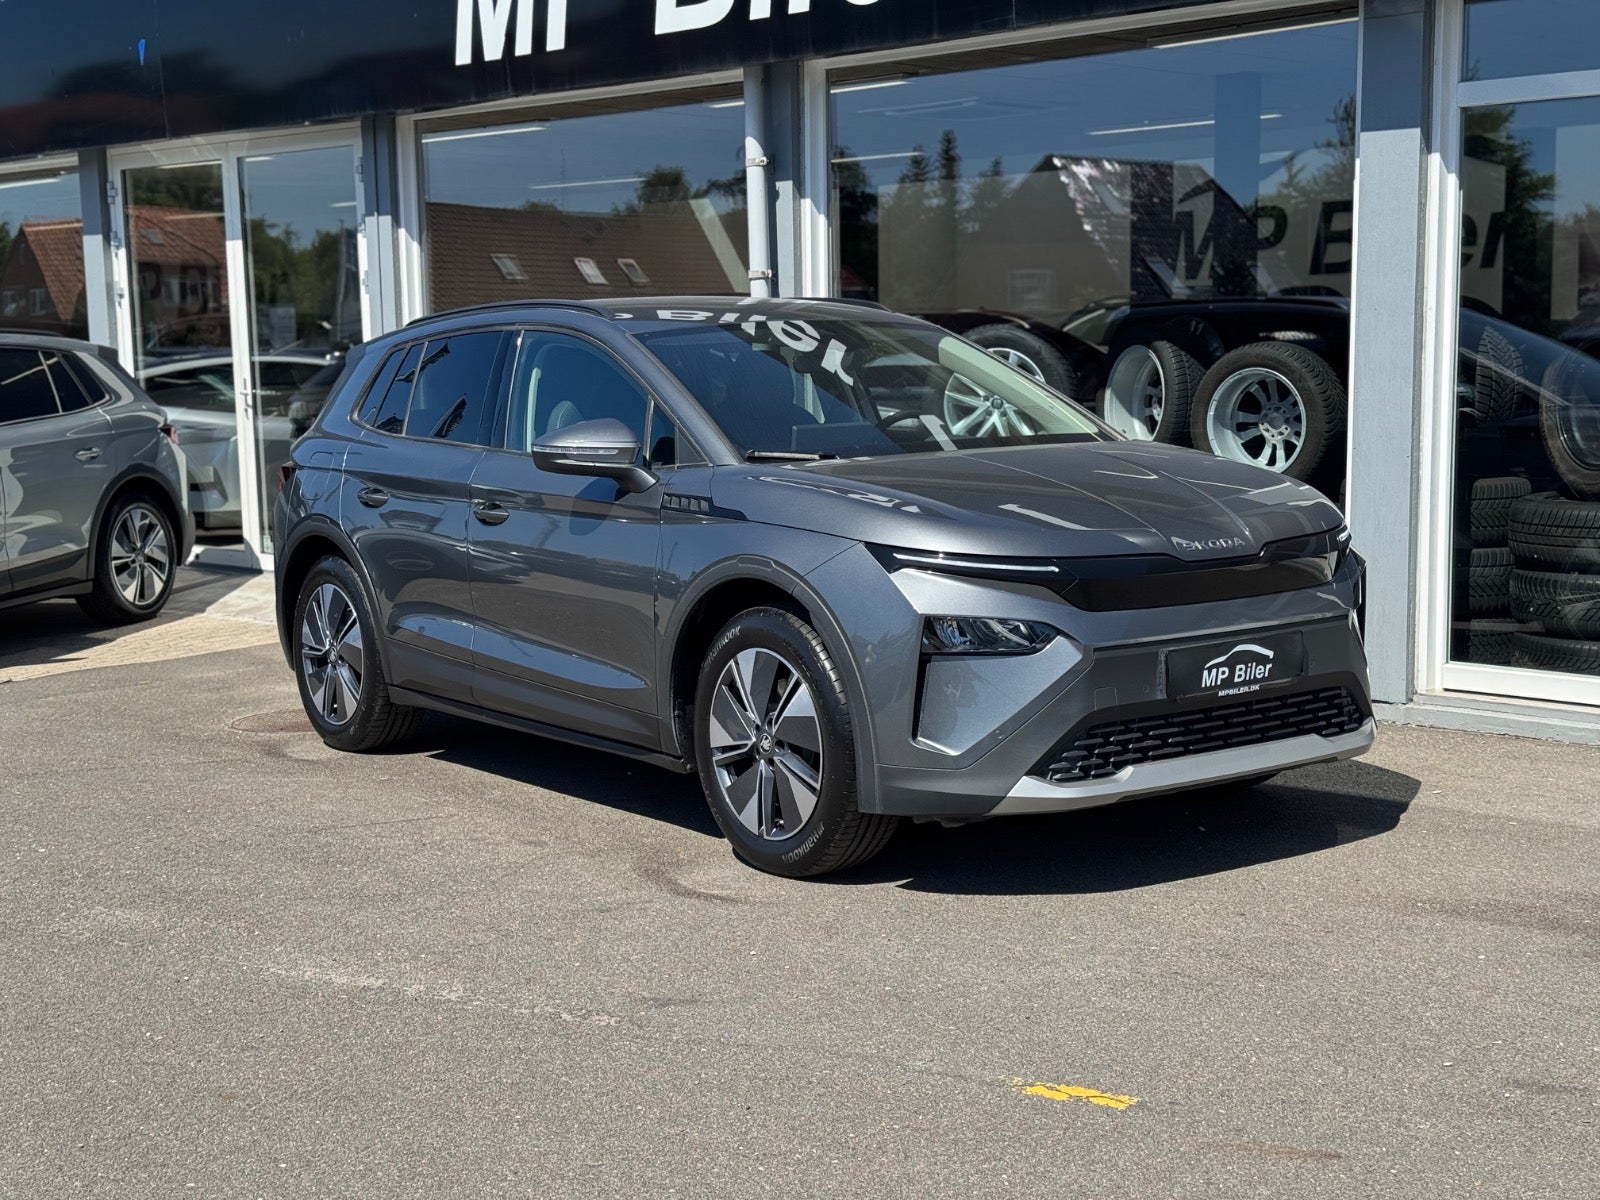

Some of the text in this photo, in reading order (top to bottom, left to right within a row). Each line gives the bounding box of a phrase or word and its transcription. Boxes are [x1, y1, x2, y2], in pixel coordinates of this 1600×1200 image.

[1201, 662, 1273, 688] MP Biler
[1217, 684, 1260, 697] MPBILER.DK
